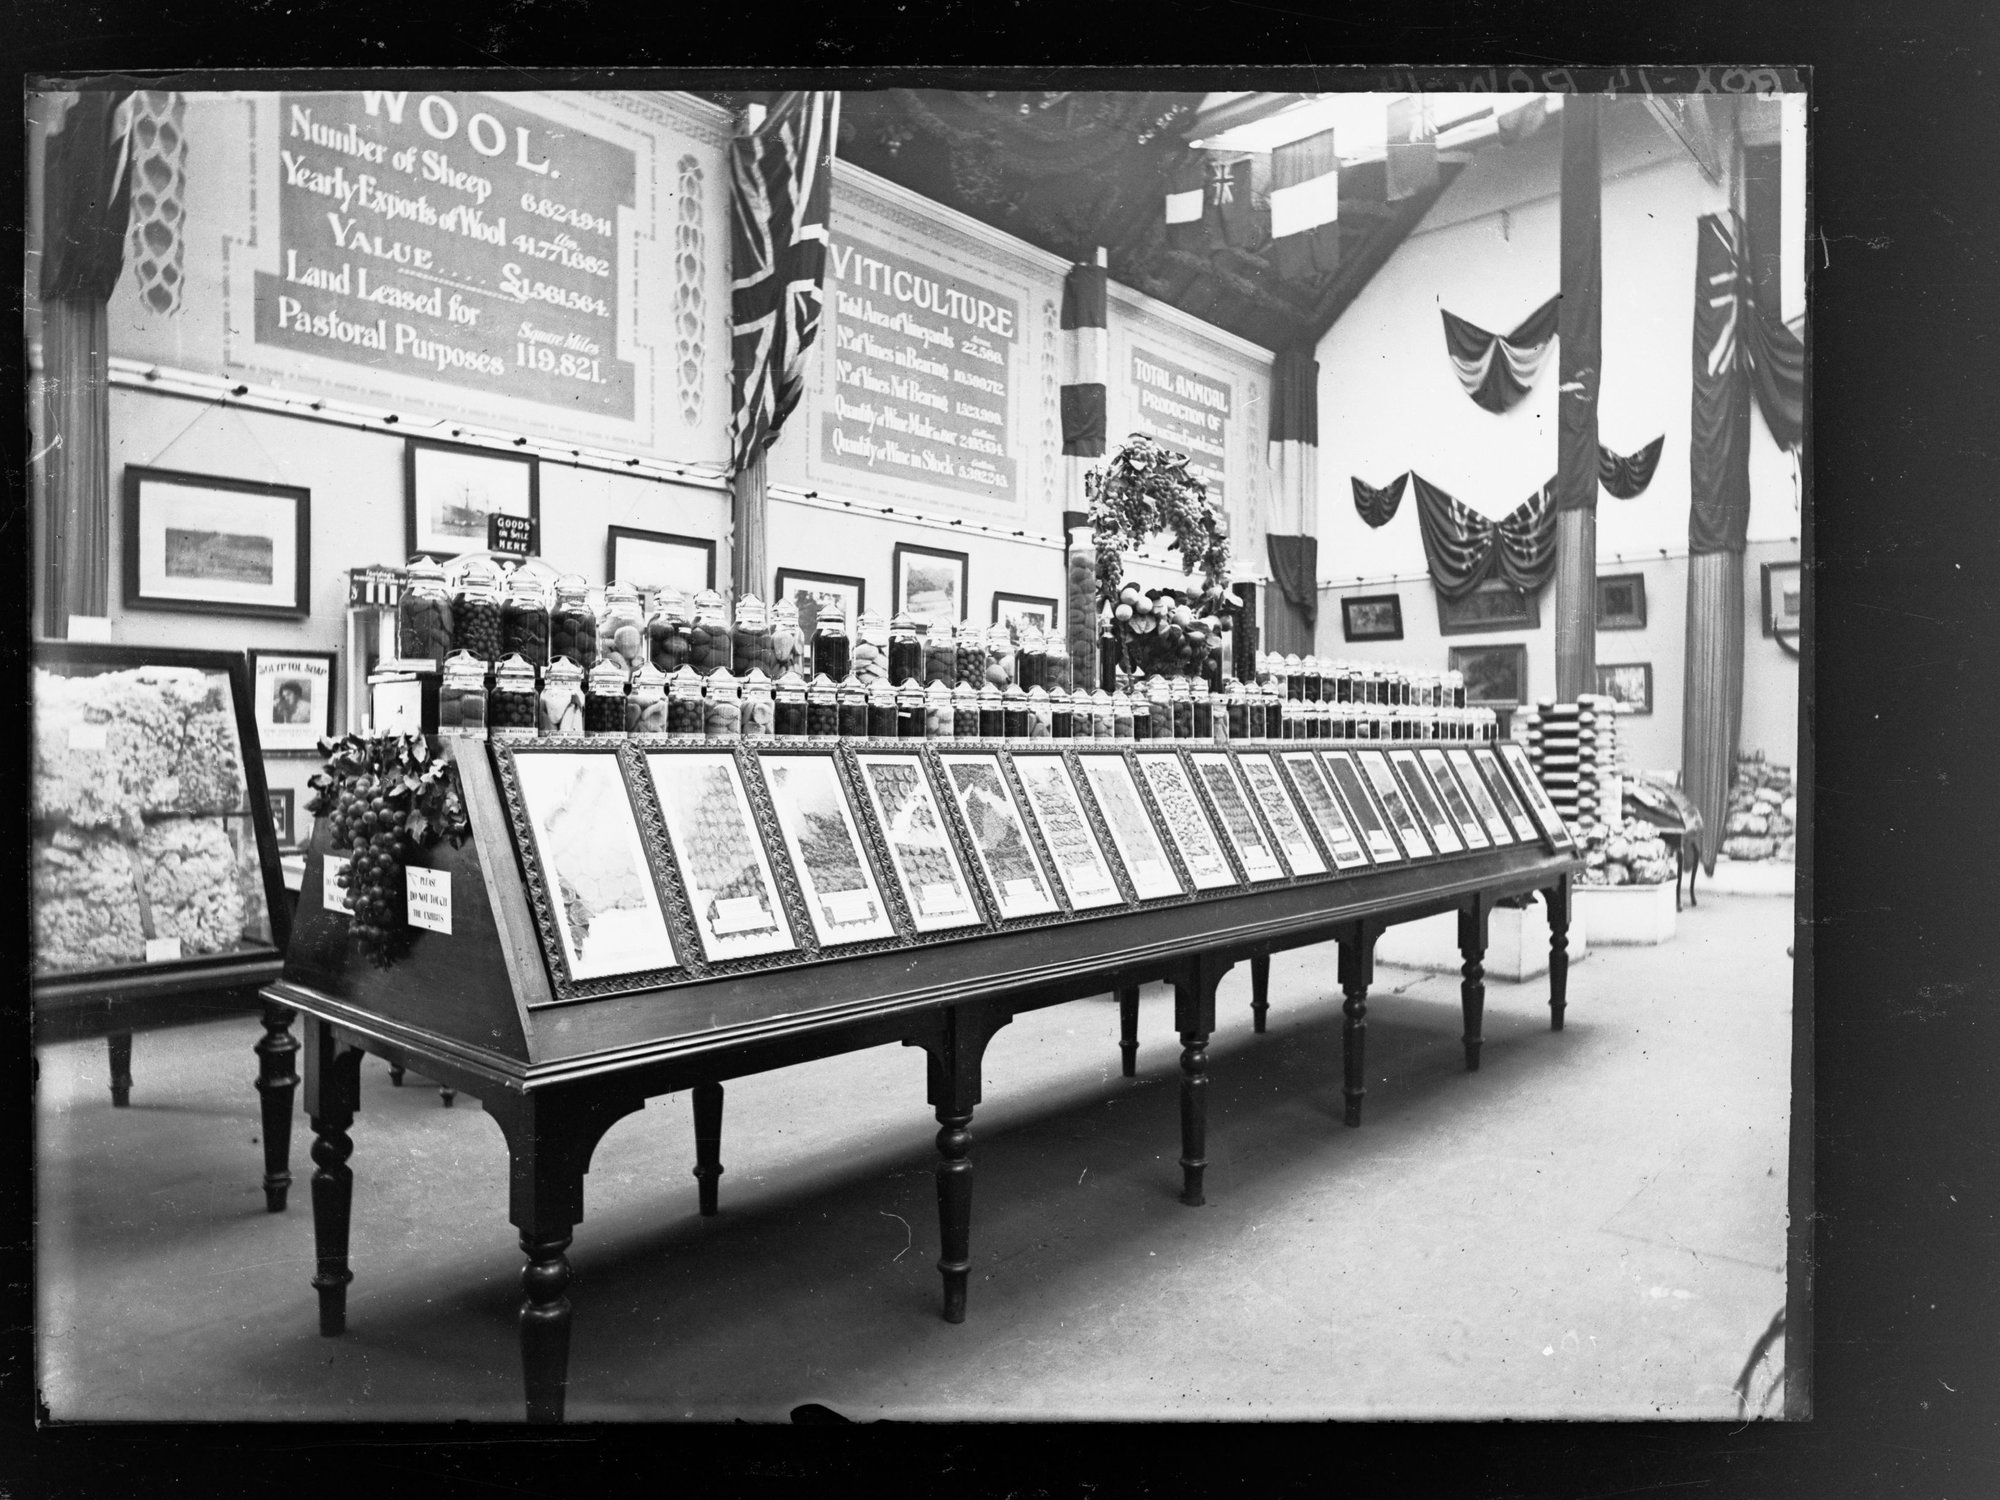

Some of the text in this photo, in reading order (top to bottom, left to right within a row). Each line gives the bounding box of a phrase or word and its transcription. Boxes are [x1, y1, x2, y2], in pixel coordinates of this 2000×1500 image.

[290, 103, 388, 165] Number
[392, 146, 418, 174] of
[422, 149, 493, 204] Sheep
[361, 92, 561, 177] WOOL.
[281, 149, 359, 213] Yearly
[358, 173, 438, 226] Exports
[439, 207, 461, 232] of
[456, 205, 507, 247] Wool
[326, 211, 434, 270] VALUE
[286, 249, 481, 326] Land Leased for
[829, 242, 1014, 339] VITICULTURE
[835, 290, 863, 319] Total
[862, 299, 890, 328] Area
[278, 294, 388, 351] Pastoral
[394, 322, 505, 376] Purposes
[564, 332, 600, 356] Miles
[894, 345, 907, 366] in
[906, 346, 949, 382] Bearing
[909, 380, 949, 414] Bearing
[1134, 357, 1229, 413] TOTAL ANNUAL
[835, 393, 878, 434] Quantity
[1142, 389, 1222, 432] PRODUCTION OF
[833, 427, 879, 467] Quantity
[885, 440, 910, 466] Wine
[911, 448, 922, 469] in
[921, 449, 955, 477] Stock
[497, 517, 531, 531] GOODS
[499, 539, 527, 552] HERE
[304, 663, 328, 677] SOAP
[410, 890, 448, 908] DO NOT TOUCH
[419, 876, 437, 888] PLEASE
[413, 908, 421, 918] THE
